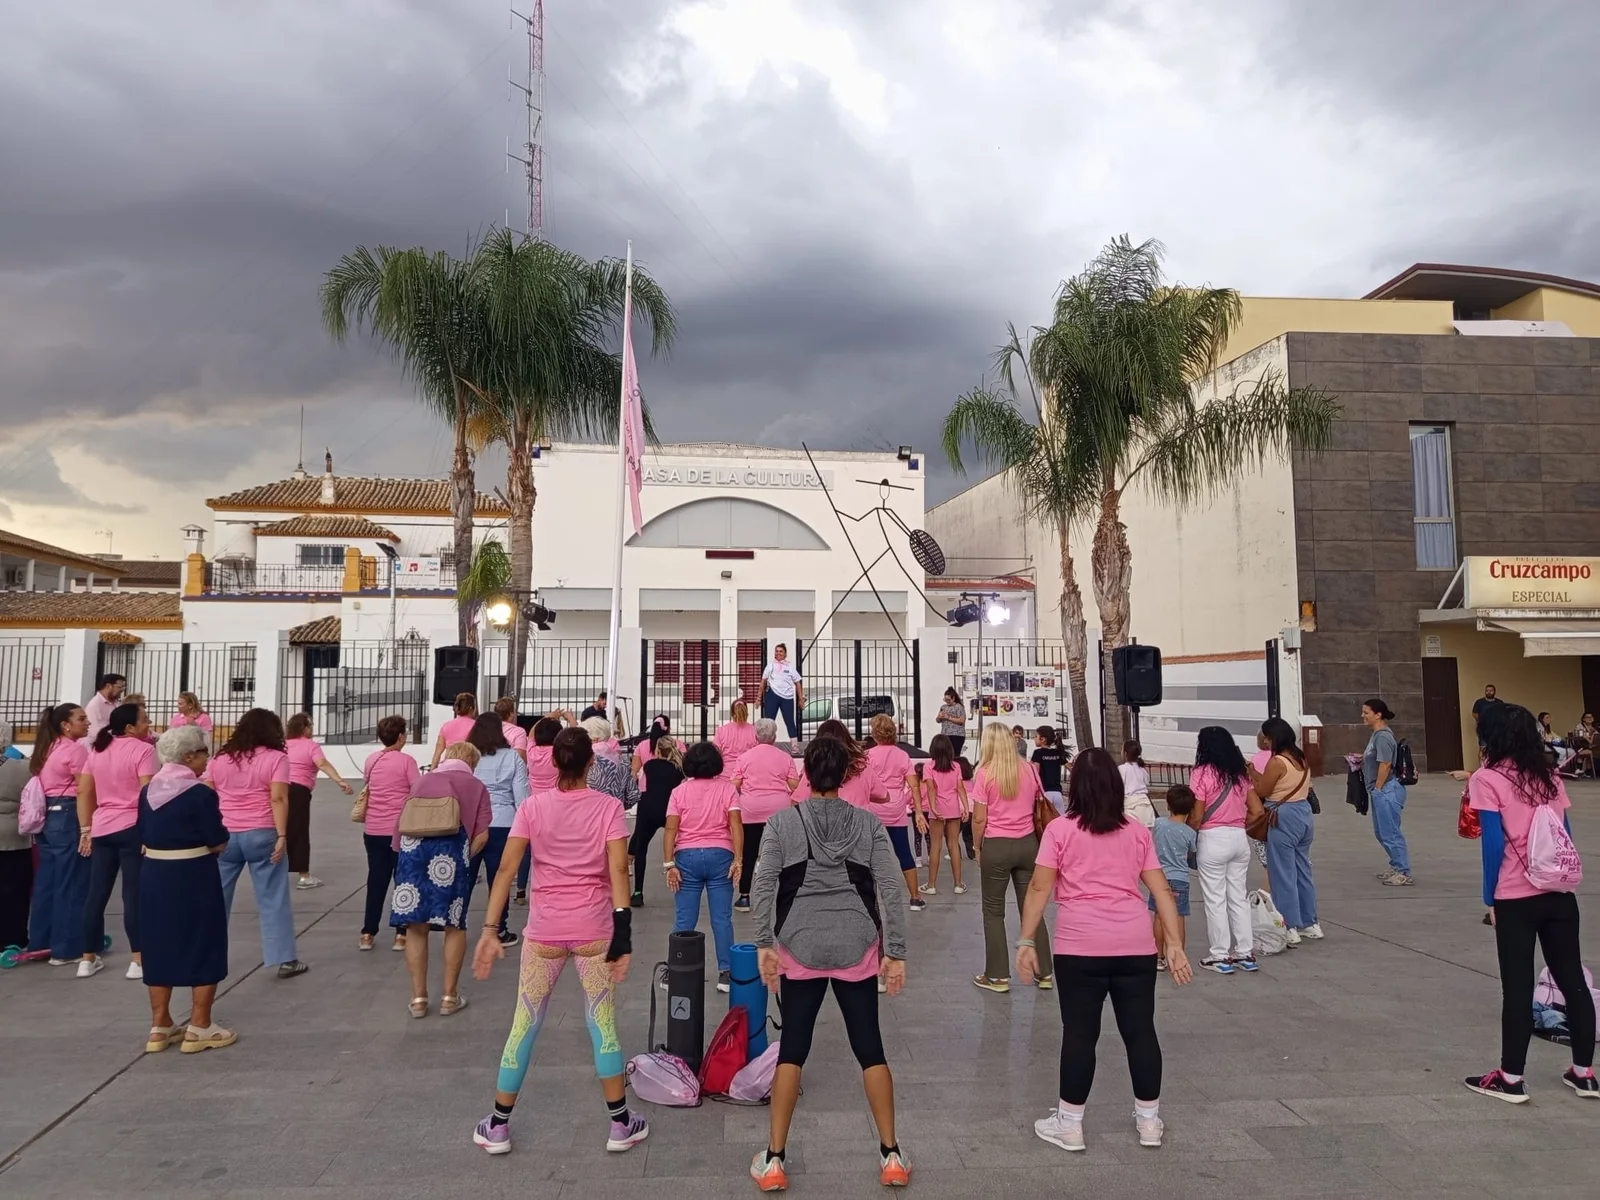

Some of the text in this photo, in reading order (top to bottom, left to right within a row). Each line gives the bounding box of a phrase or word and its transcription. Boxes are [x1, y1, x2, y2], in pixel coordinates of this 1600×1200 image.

[643, 468, 828, 487] ASA DE LA CULTURA
[1489, 559, 1591, 582] Cruzcampo
[1512, 591, 1572, 602] ESPECIAL
